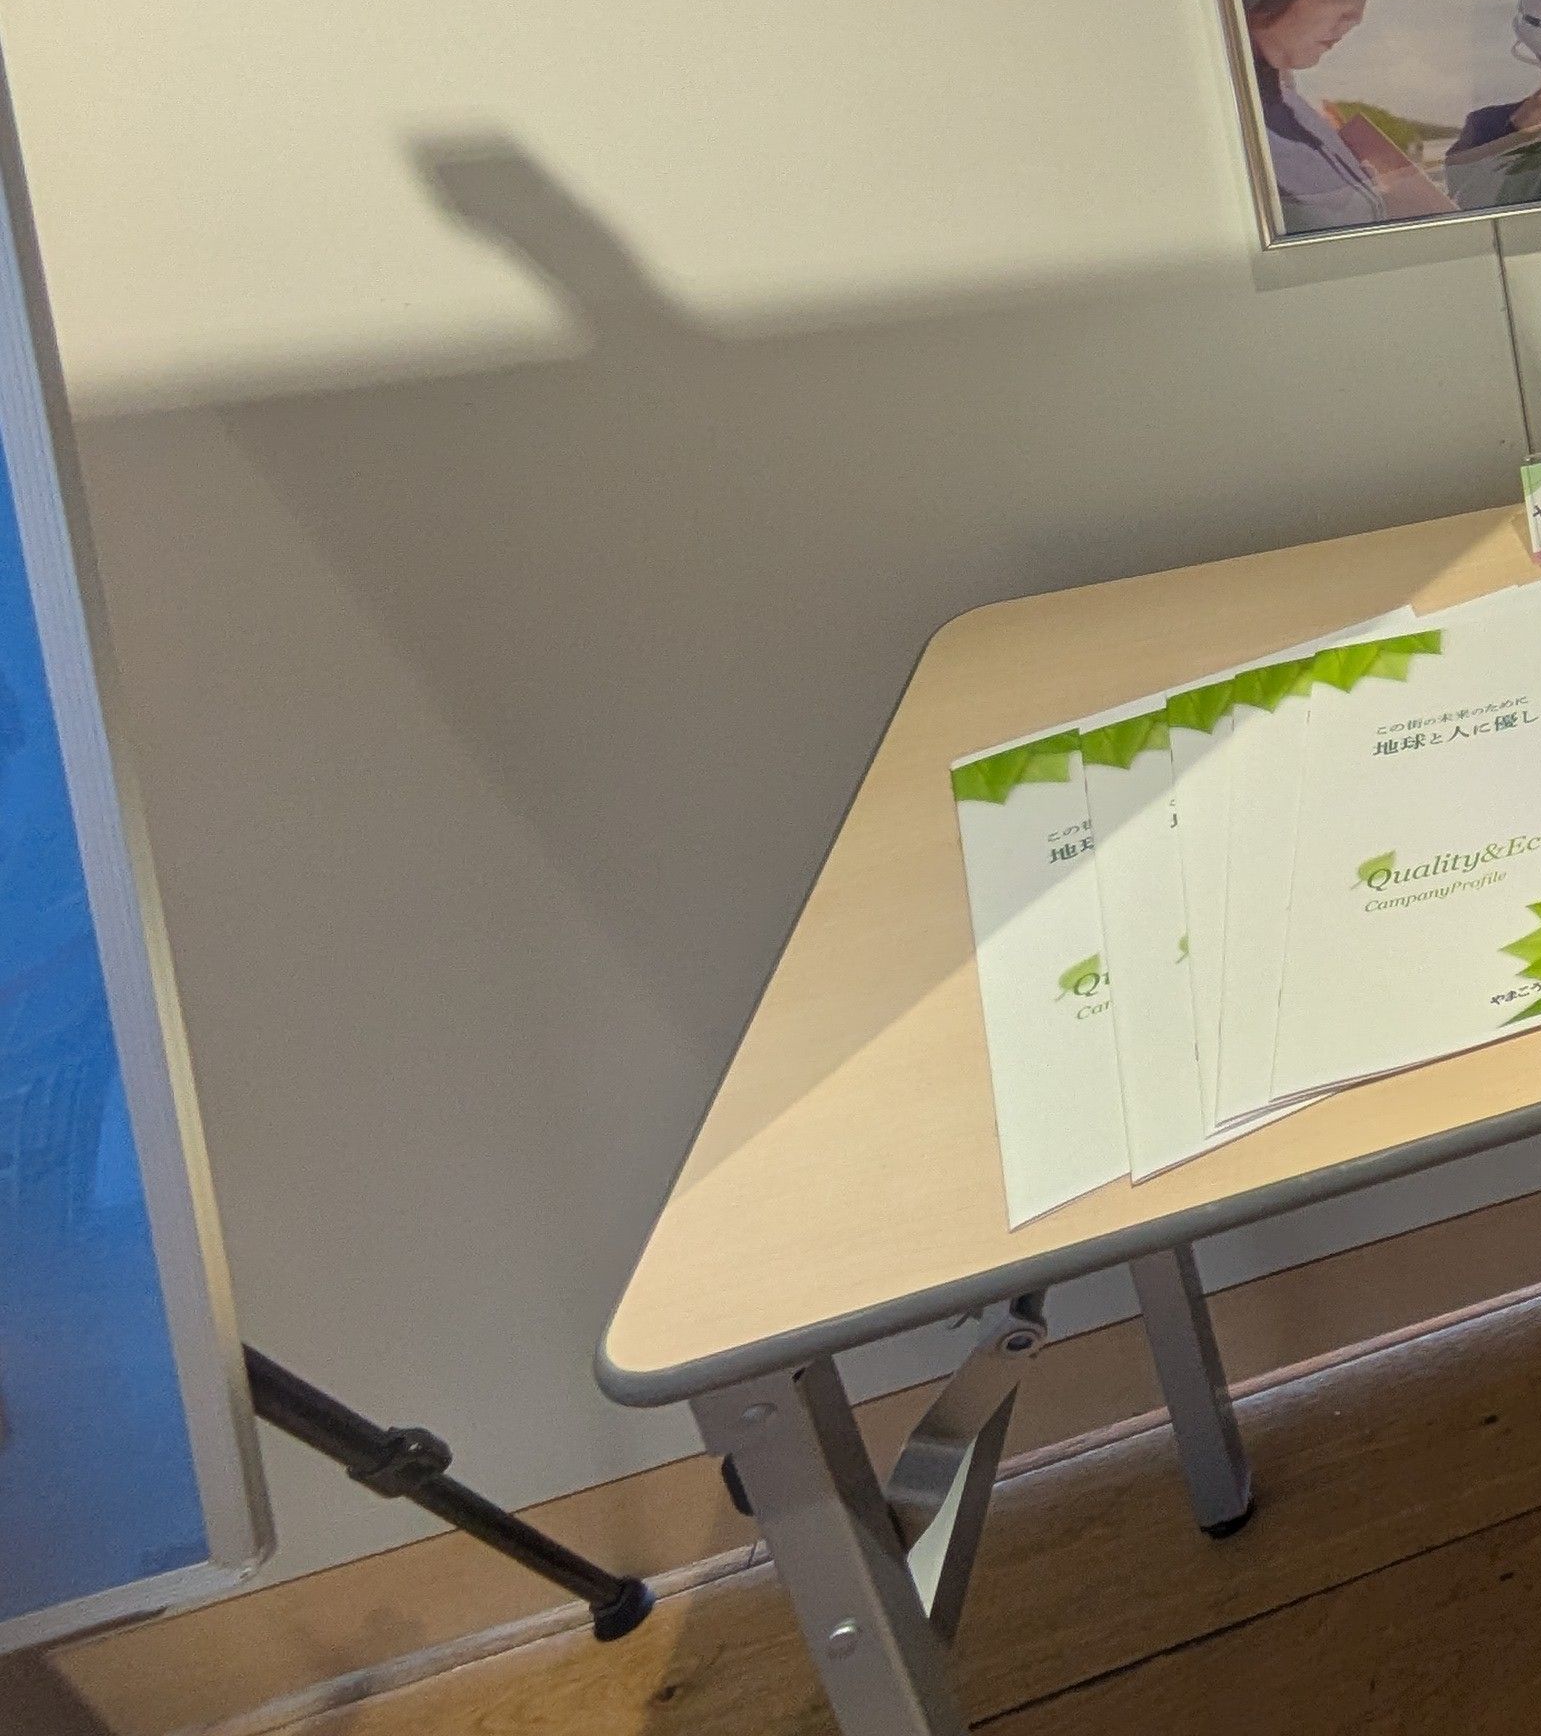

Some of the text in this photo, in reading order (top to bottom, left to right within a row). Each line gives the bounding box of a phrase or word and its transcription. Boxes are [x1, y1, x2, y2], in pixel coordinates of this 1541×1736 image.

[1376, 696, 1529, 735] この街の未来のために
[1364, 870, 1507, 913] CompanyProfile
